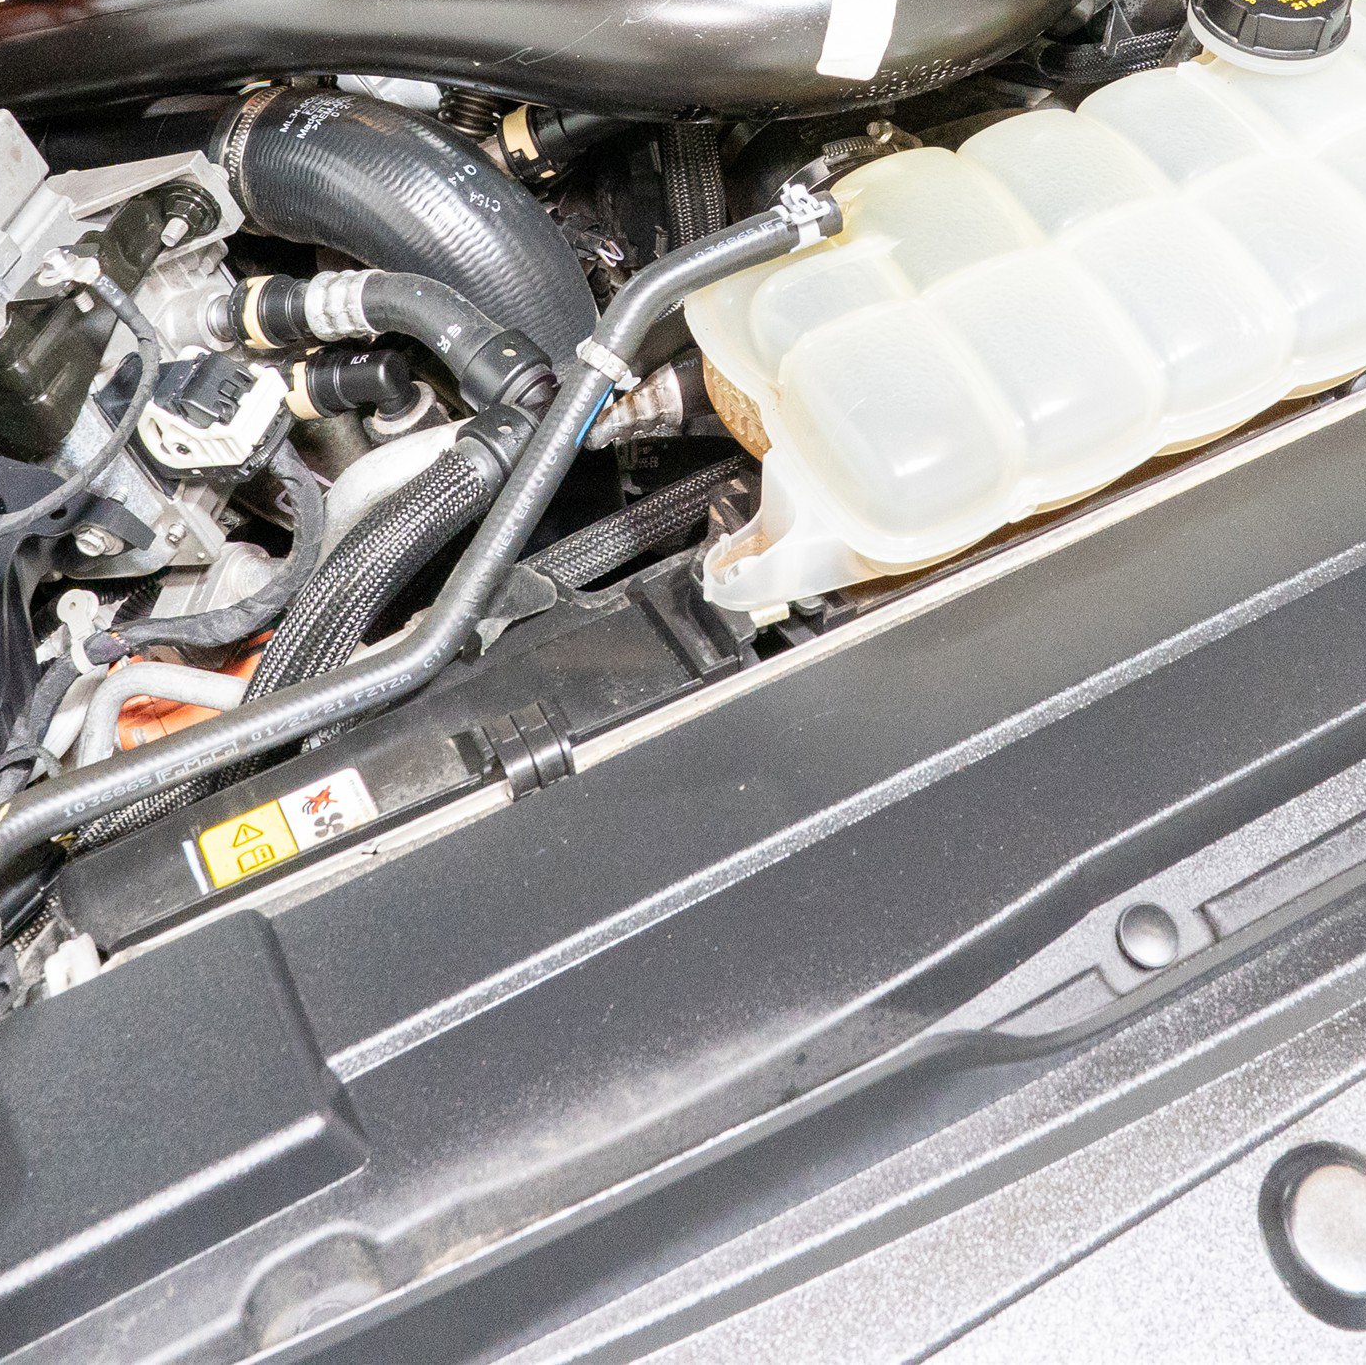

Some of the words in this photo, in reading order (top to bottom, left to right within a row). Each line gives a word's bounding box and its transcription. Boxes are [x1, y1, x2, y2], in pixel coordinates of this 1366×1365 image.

[1290, 0, 1308, 11] 21
[469, 191, 501, 213] C154
[447, 323, 462, 339] UP
[157, 742, 238, 783] FoMoCo
[250, 699, 346, 742] 01/24/21
